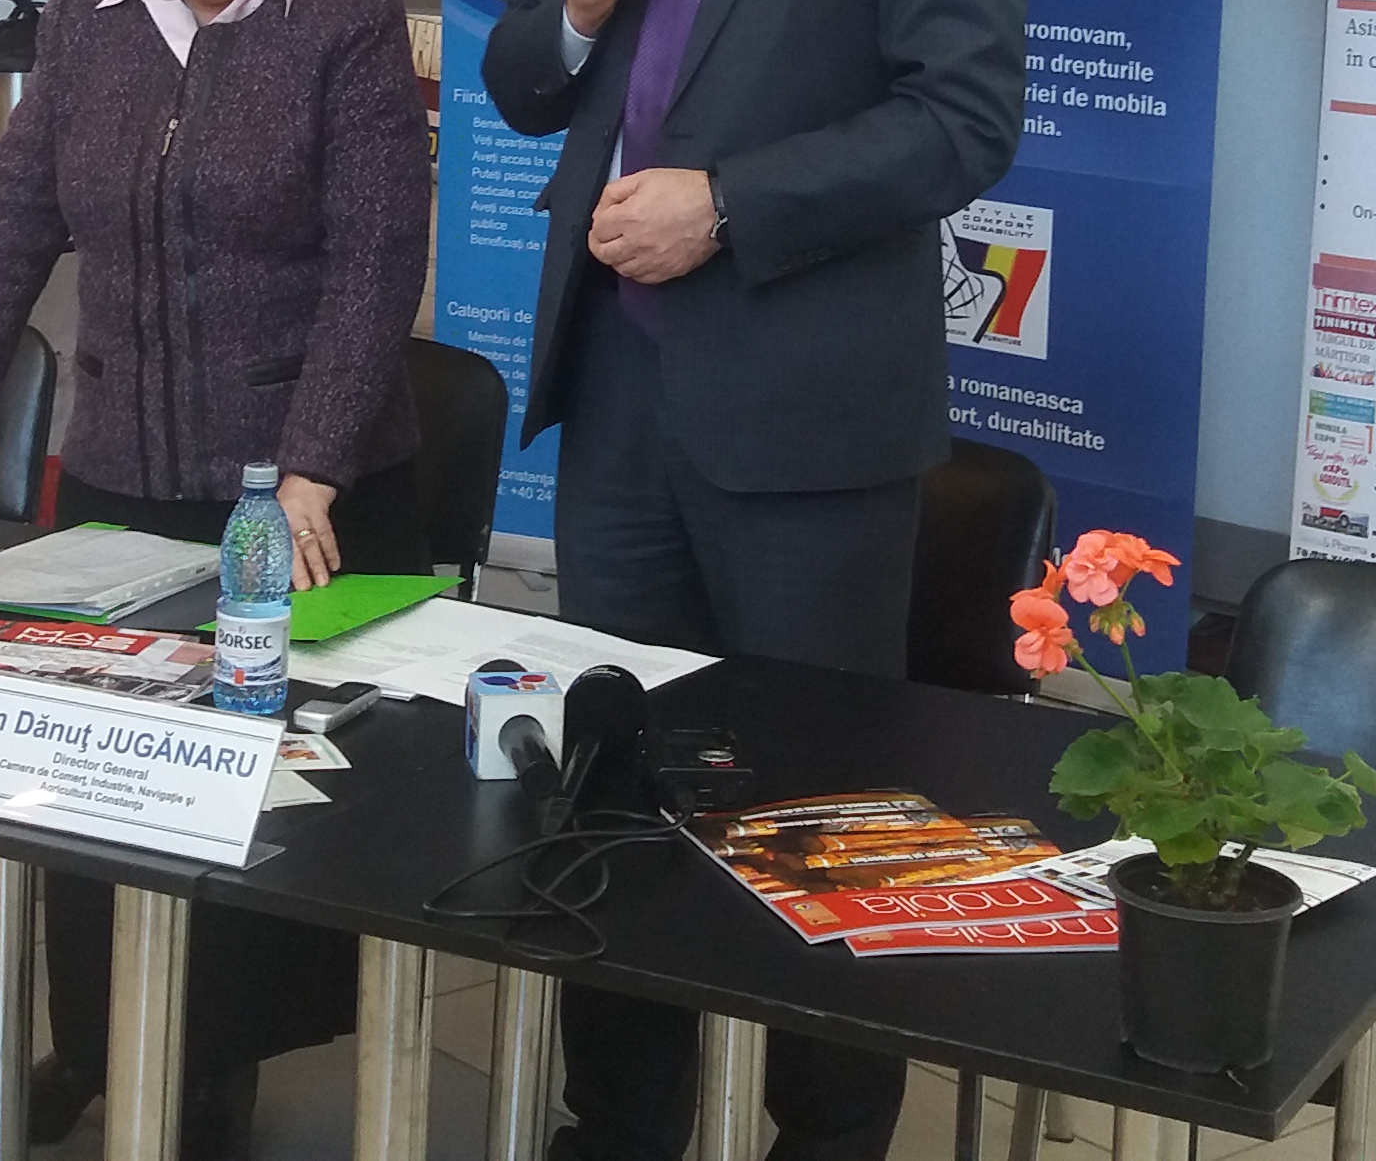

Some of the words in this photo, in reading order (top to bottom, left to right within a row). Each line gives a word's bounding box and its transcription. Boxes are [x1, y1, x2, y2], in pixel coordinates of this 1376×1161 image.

[1050, 53, 1154, 82] drepturile
[1346, 48, 1363, 67] în
[1024, 82, 1057, 104] riei
[1062, 87, 1089, 107] de
[1094, 93, 1167, 116] mobila
[1023, 114, 1061, 136] nia.
[960, 378, 1084, 415] romaneasca
[949, 407, 982, 430] ort,
[987, 411, 1105, 451] durabilitate
[218, 628, 273, 650] BORSEC
[52, 751, 101, 771] Director
[102, 761, 149, 781] General
[97, 727, 258, 778] JUGĂNARU
[0, 758, 35, 774] Camera
[37, 767, 49, 777] de
[90, 776, 135, 795] Industrie,
[851, 885, 1053, 918] mobila
